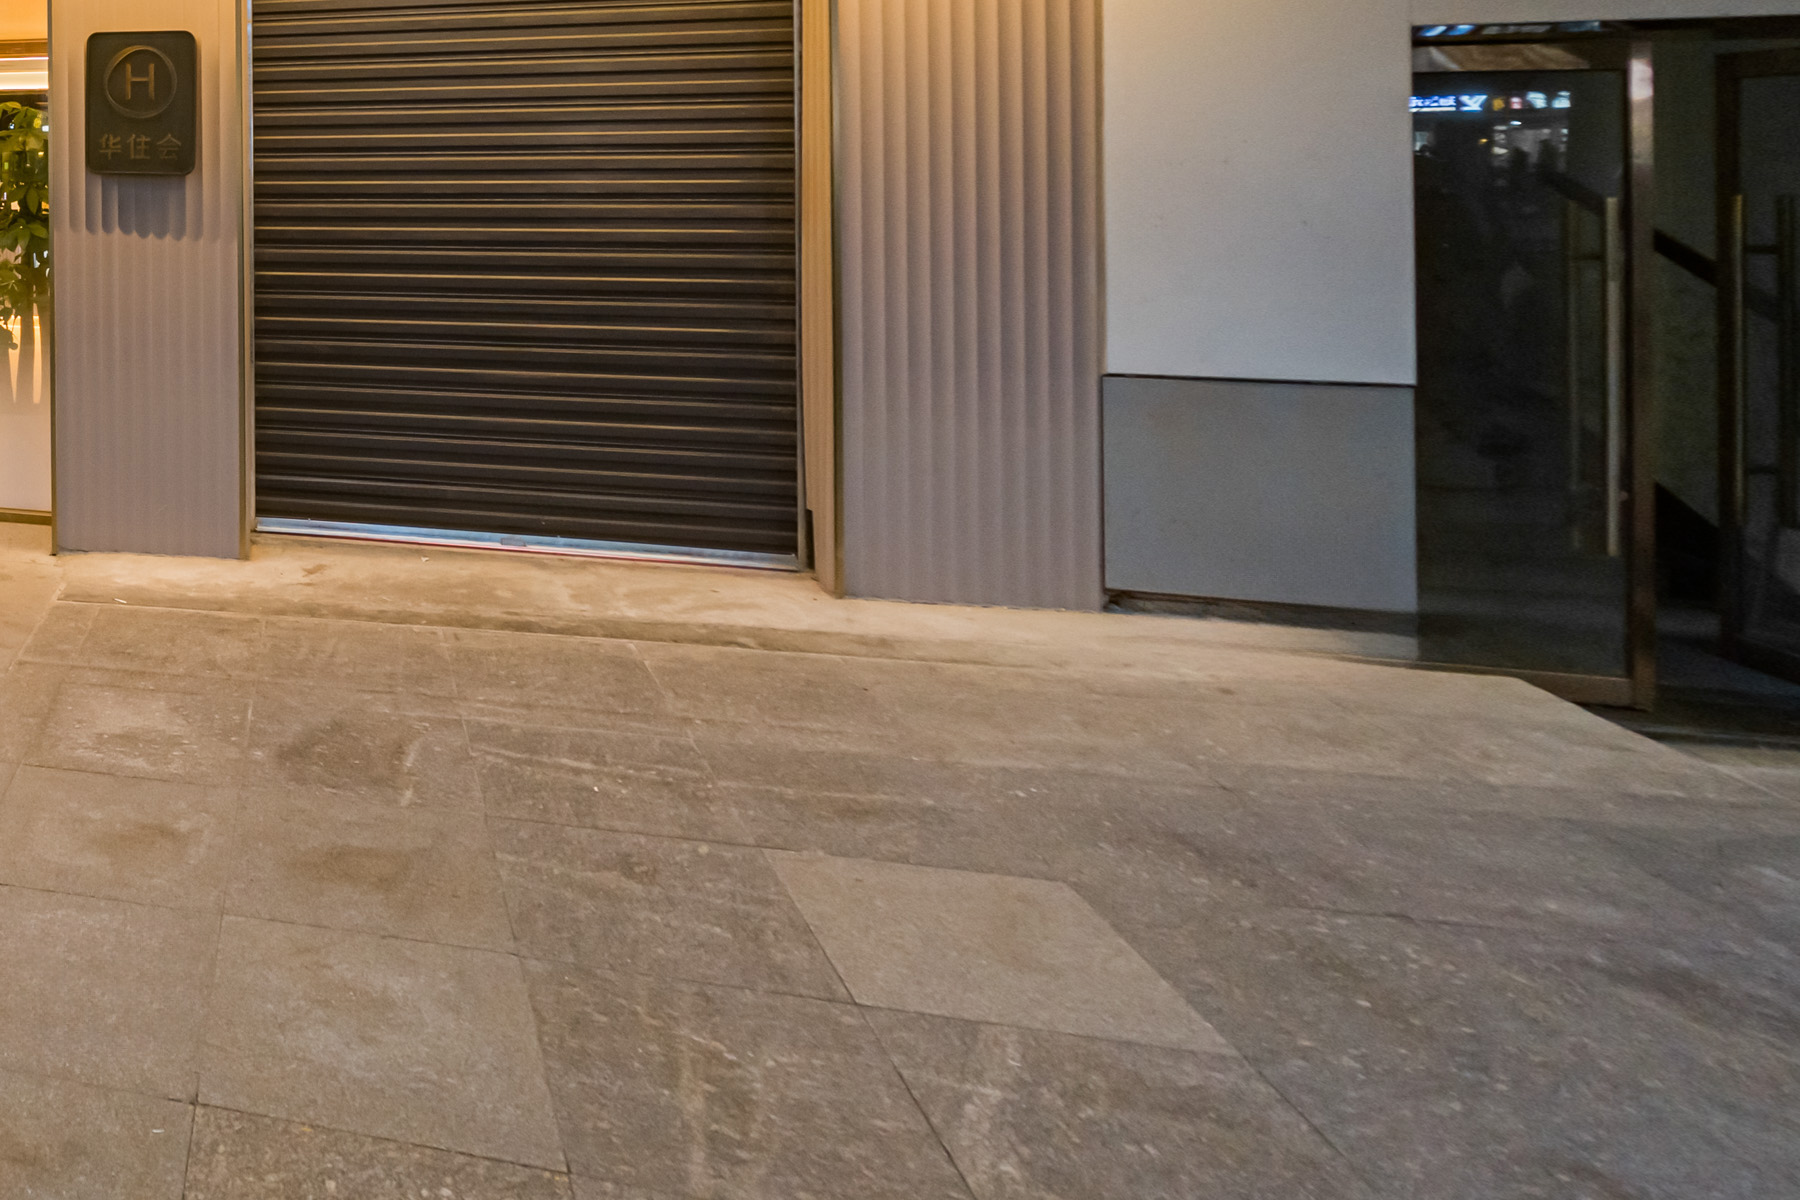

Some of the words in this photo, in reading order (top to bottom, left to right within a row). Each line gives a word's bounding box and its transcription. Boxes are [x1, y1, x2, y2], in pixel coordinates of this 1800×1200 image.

[125, 63, 155, 100] H
[99, 133, 182, 160] 华住会
